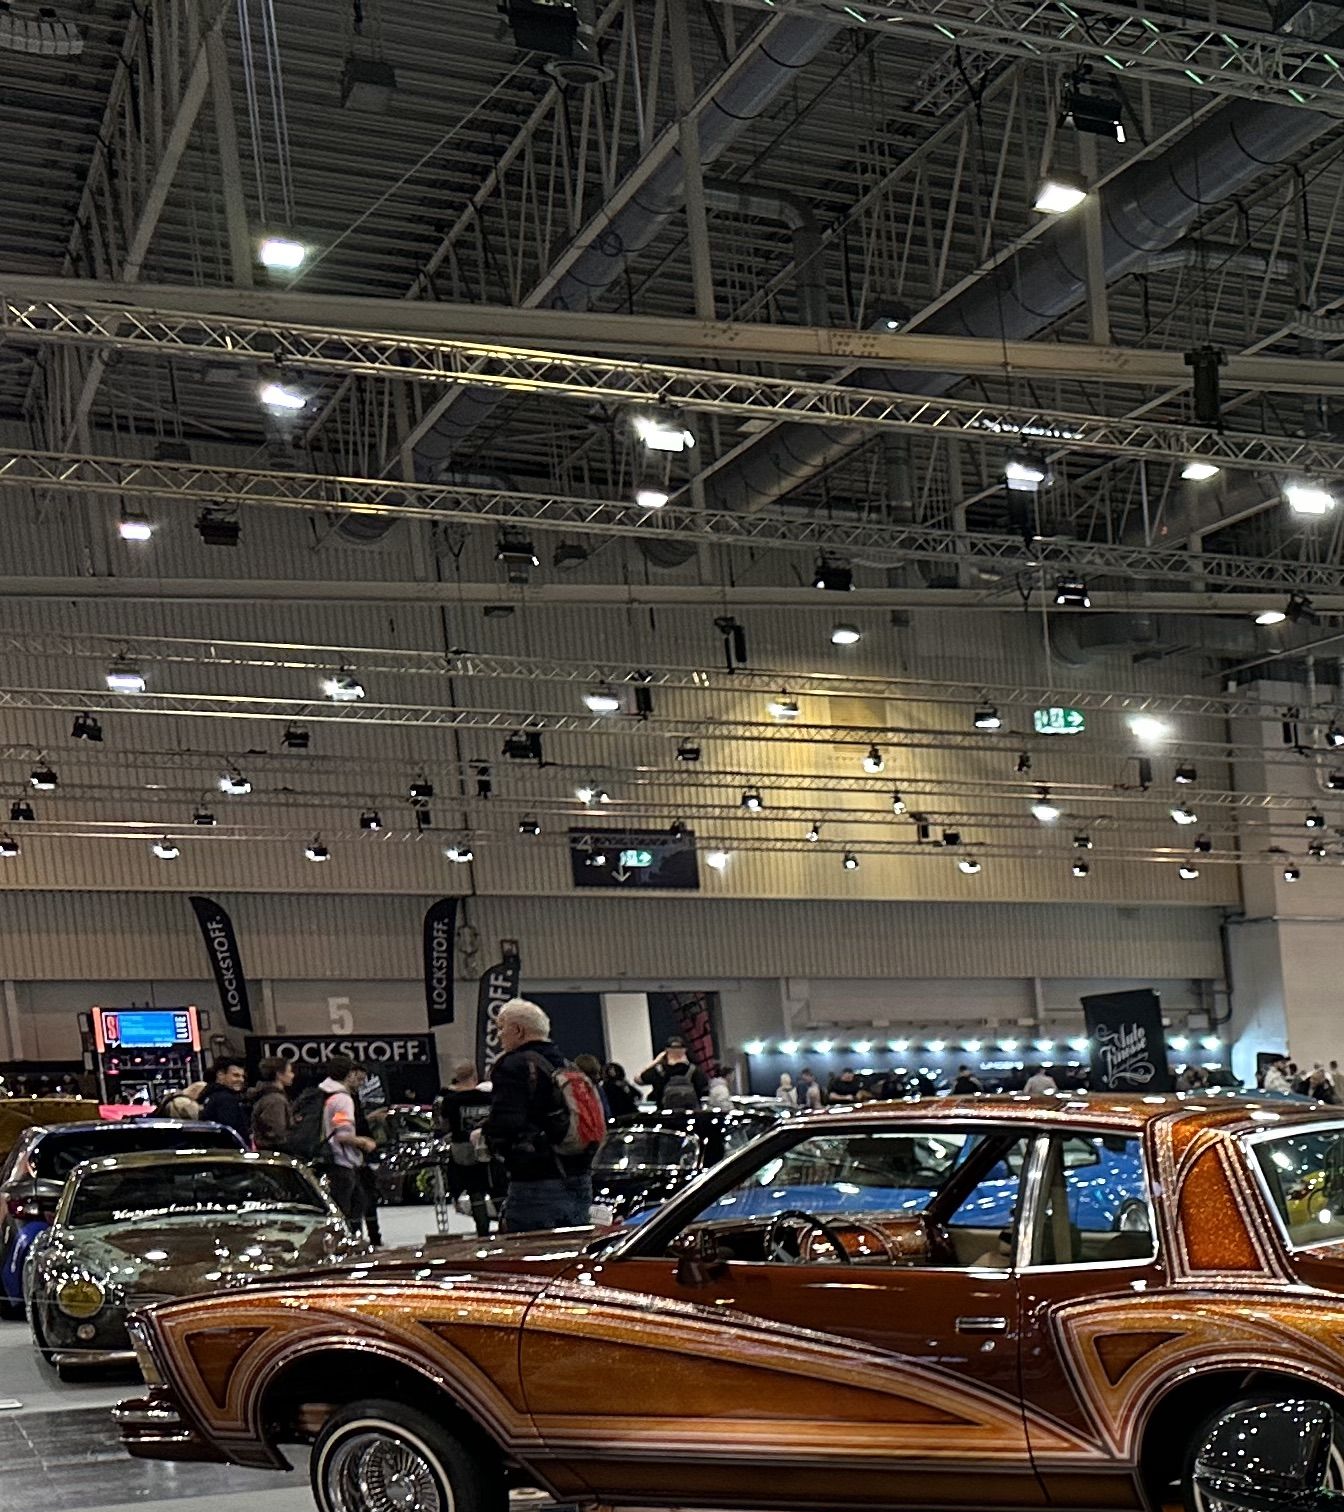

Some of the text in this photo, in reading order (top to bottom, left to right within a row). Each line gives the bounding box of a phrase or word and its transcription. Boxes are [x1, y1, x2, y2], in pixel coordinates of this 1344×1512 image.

[206, 916, 241, 1012] LOCKSTOFF.
[432, 918, 449, 1010] LOCKSTOFF.
[327, 996, 354, 1036] 5
[263, 1041, 428, 1064] LOCKSTOFF.
